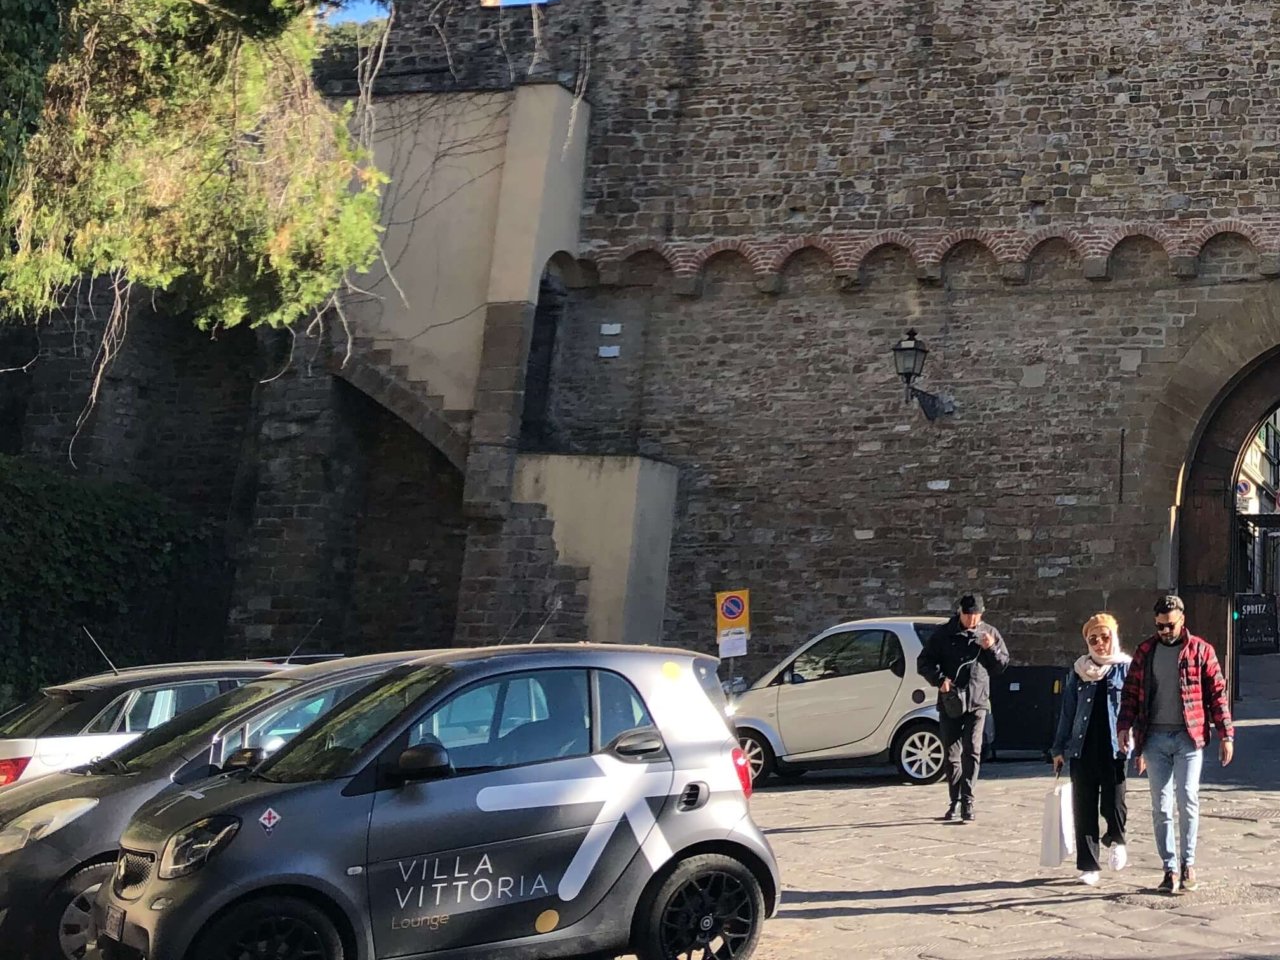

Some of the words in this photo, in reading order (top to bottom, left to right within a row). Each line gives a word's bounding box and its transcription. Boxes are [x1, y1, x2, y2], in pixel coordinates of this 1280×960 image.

[1242, 604, 1267, 615] SPRITZ
[399, 853, 493, 882] VILLA
[395, 874, 549, 909] VITTORIA
[391, 914, 450, 930] Lounge
